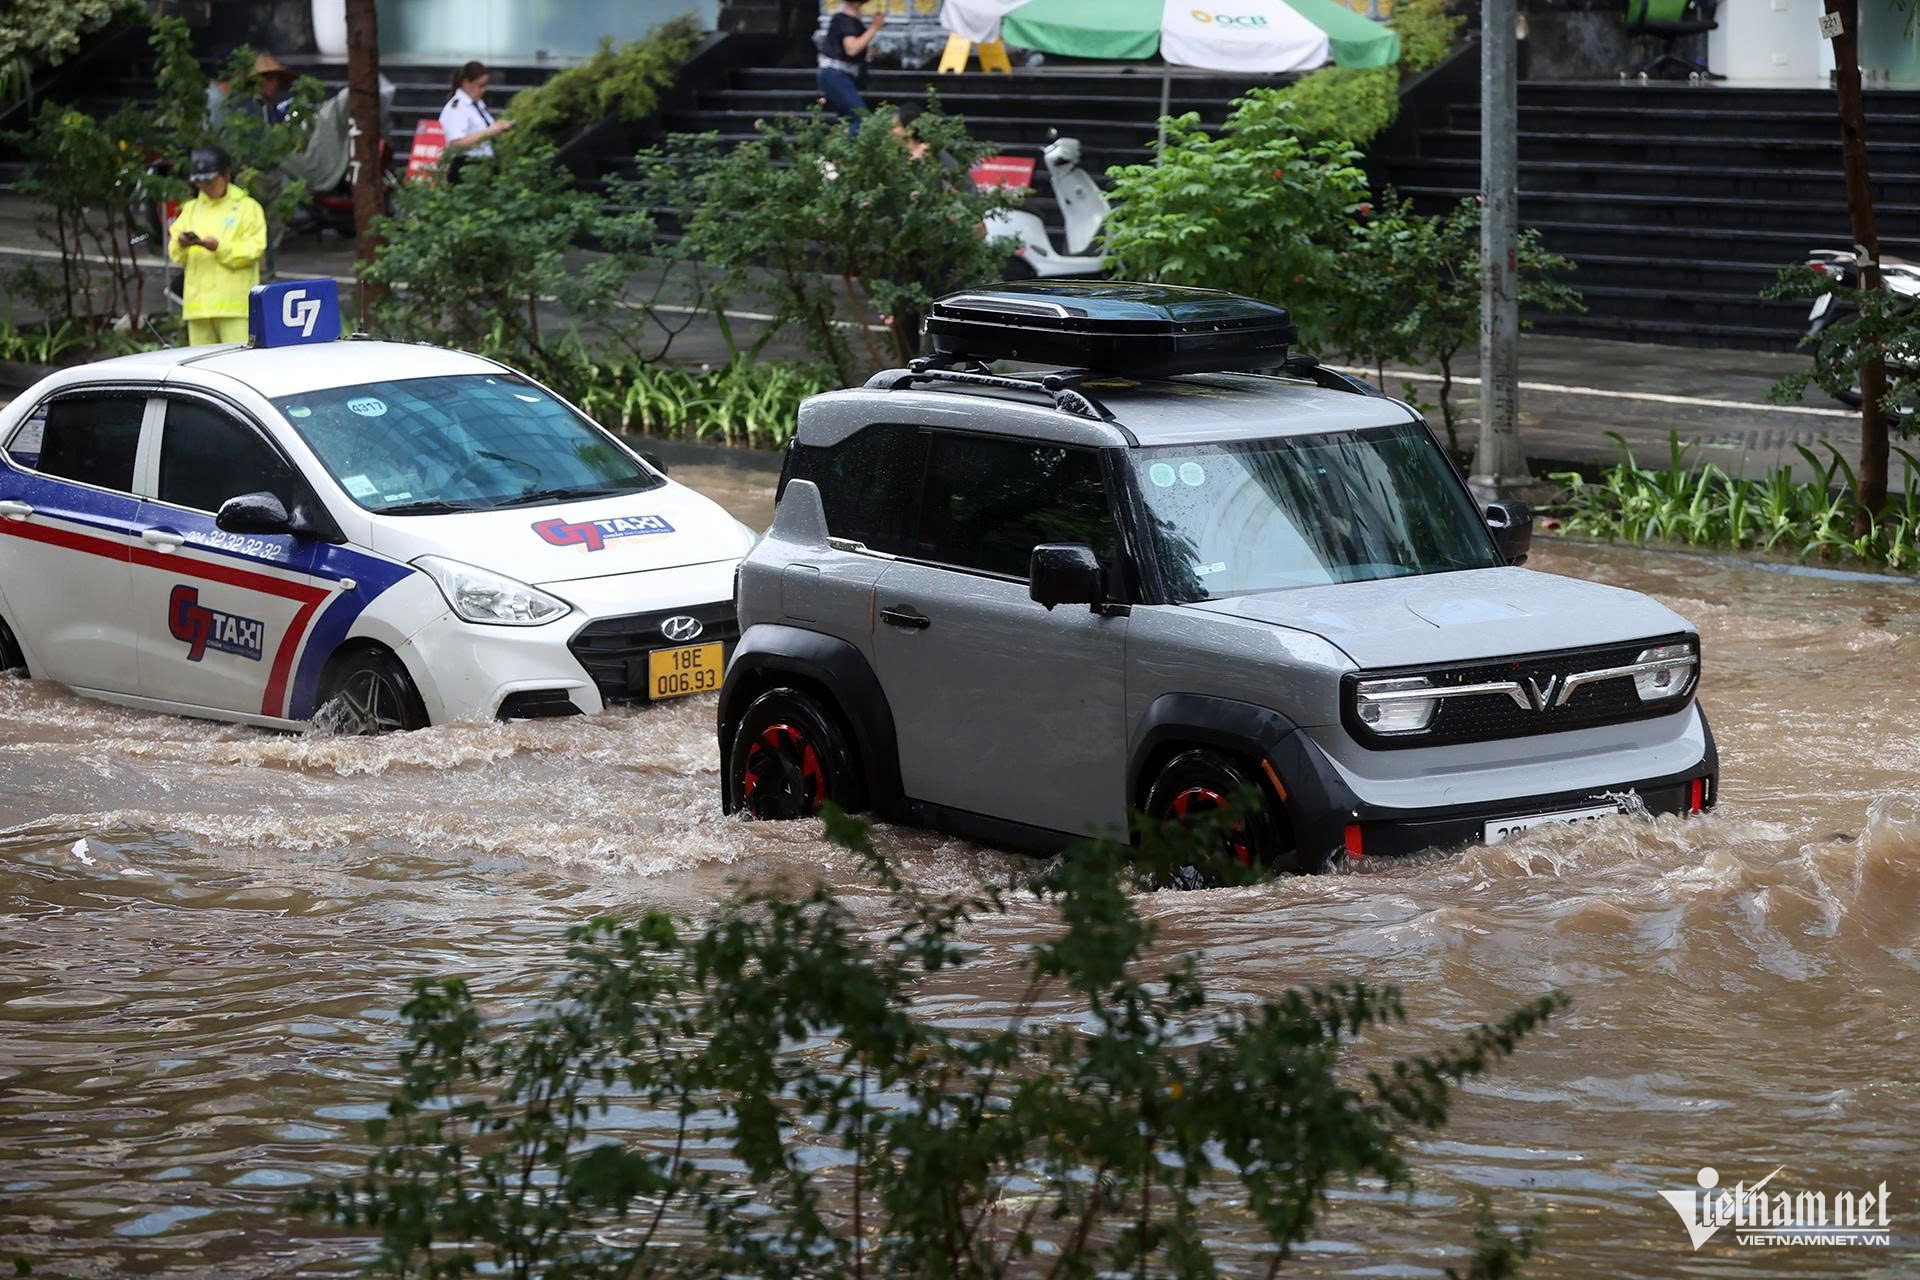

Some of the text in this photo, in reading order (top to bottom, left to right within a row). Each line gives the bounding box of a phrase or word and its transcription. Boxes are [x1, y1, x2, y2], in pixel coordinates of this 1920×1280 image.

[282, 289, 321, 338] G7
[351, 401, 384, 413] 4317
[530, 518, 605, 552] G7
[593, 516, 666, 533] TAXI
[168, 584, 262, 662] G7 TAXI
[672, 648, 702, 670] 18E
[658, 669, 715, 694] 006.93
